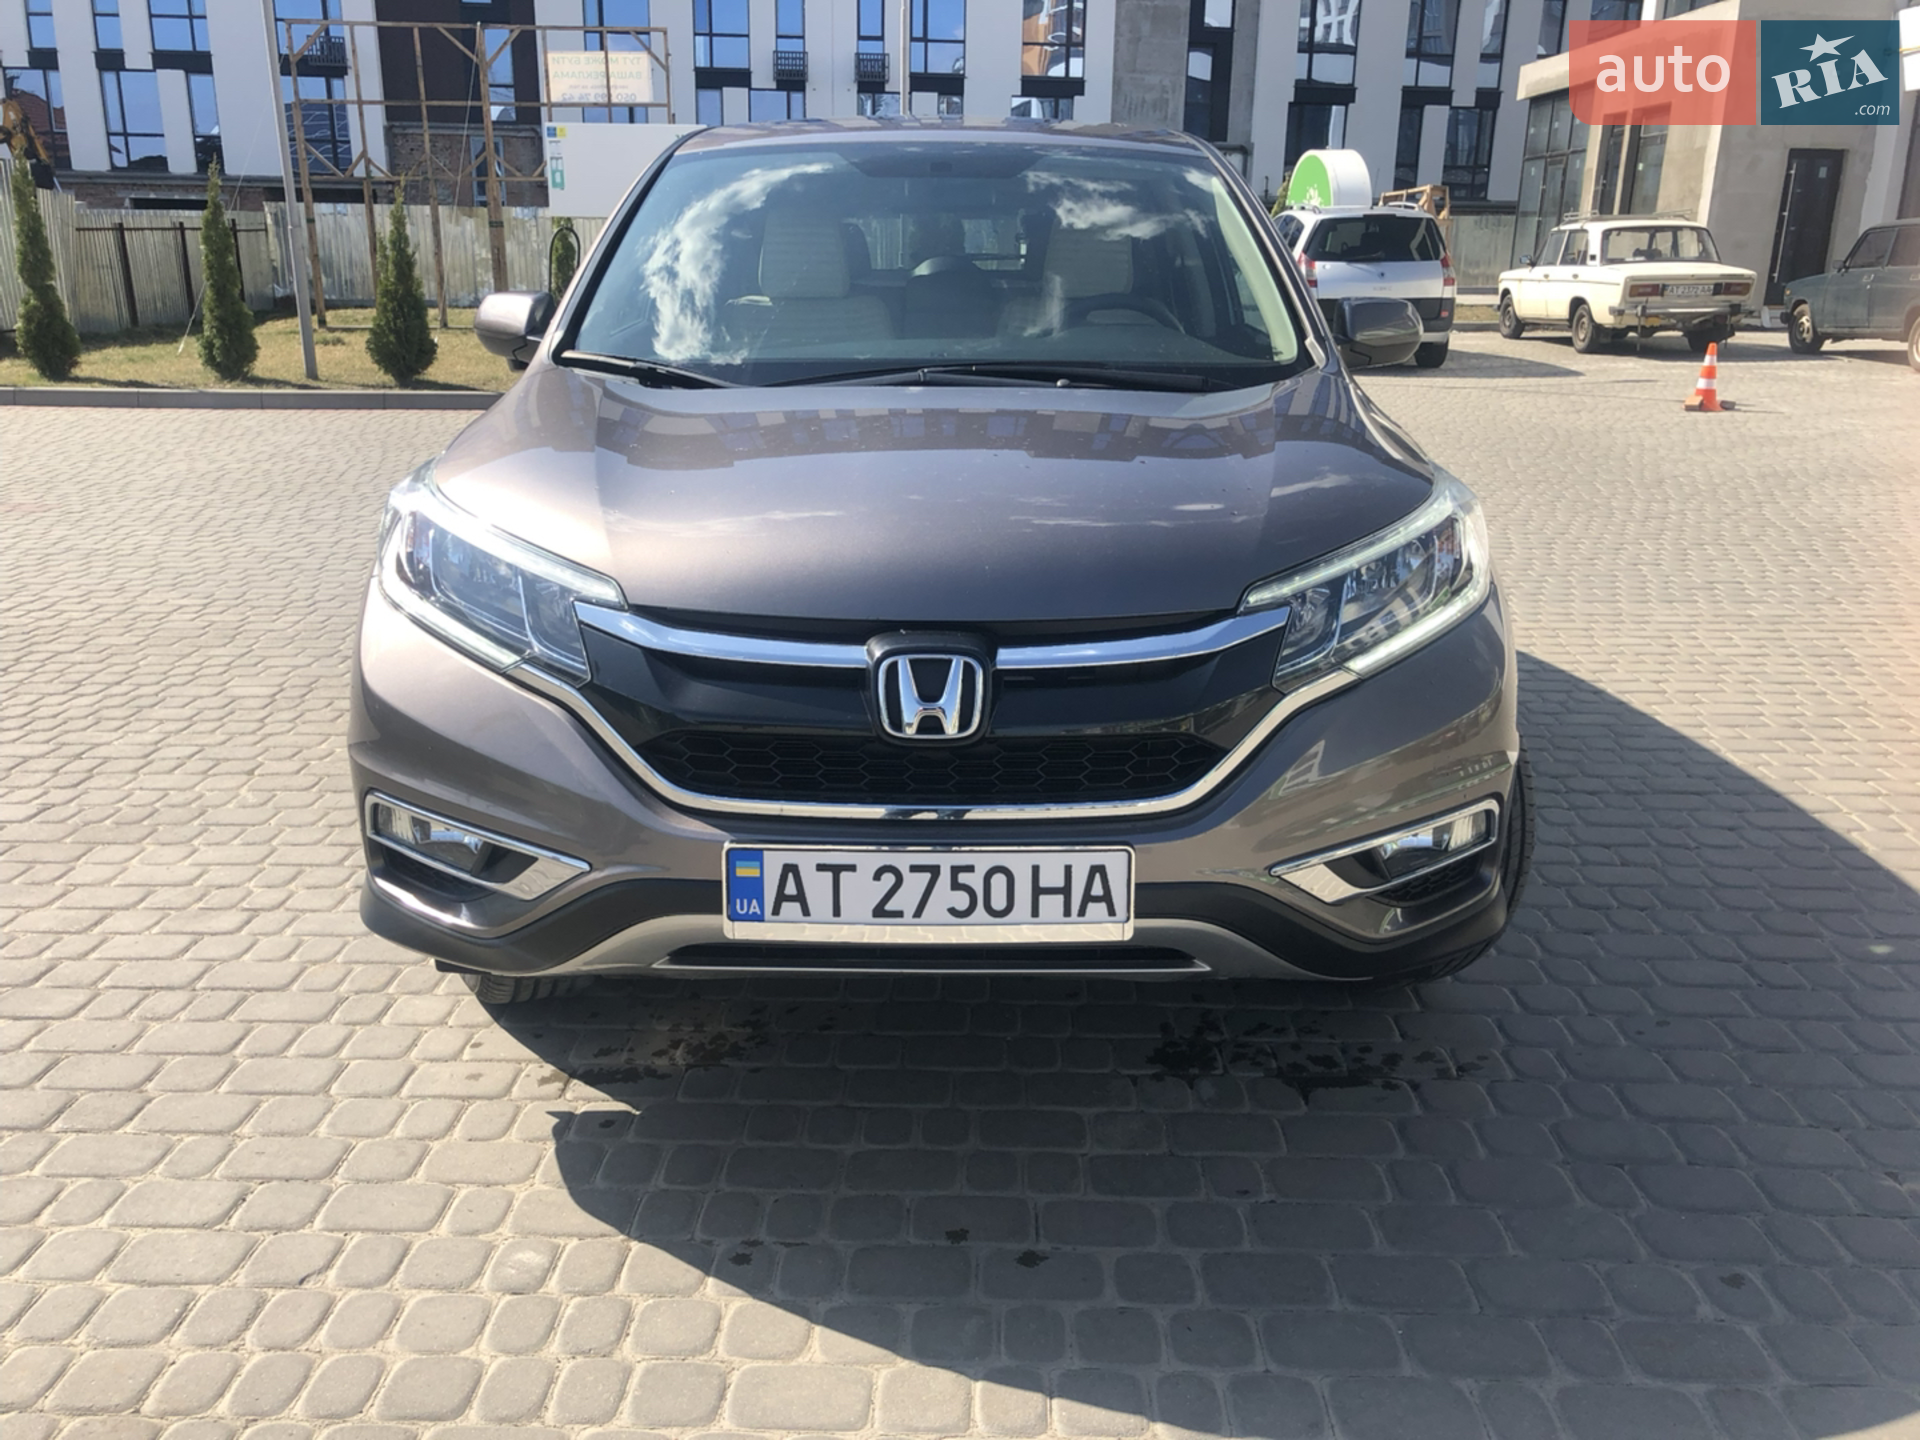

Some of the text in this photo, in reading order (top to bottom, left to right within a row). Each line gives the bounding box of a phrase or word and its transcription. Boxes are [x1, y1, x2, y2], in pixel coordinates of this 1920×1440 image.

[736, 898, 761, 916] UA
[771, 863, 1117, 919] AT 2750 HA
